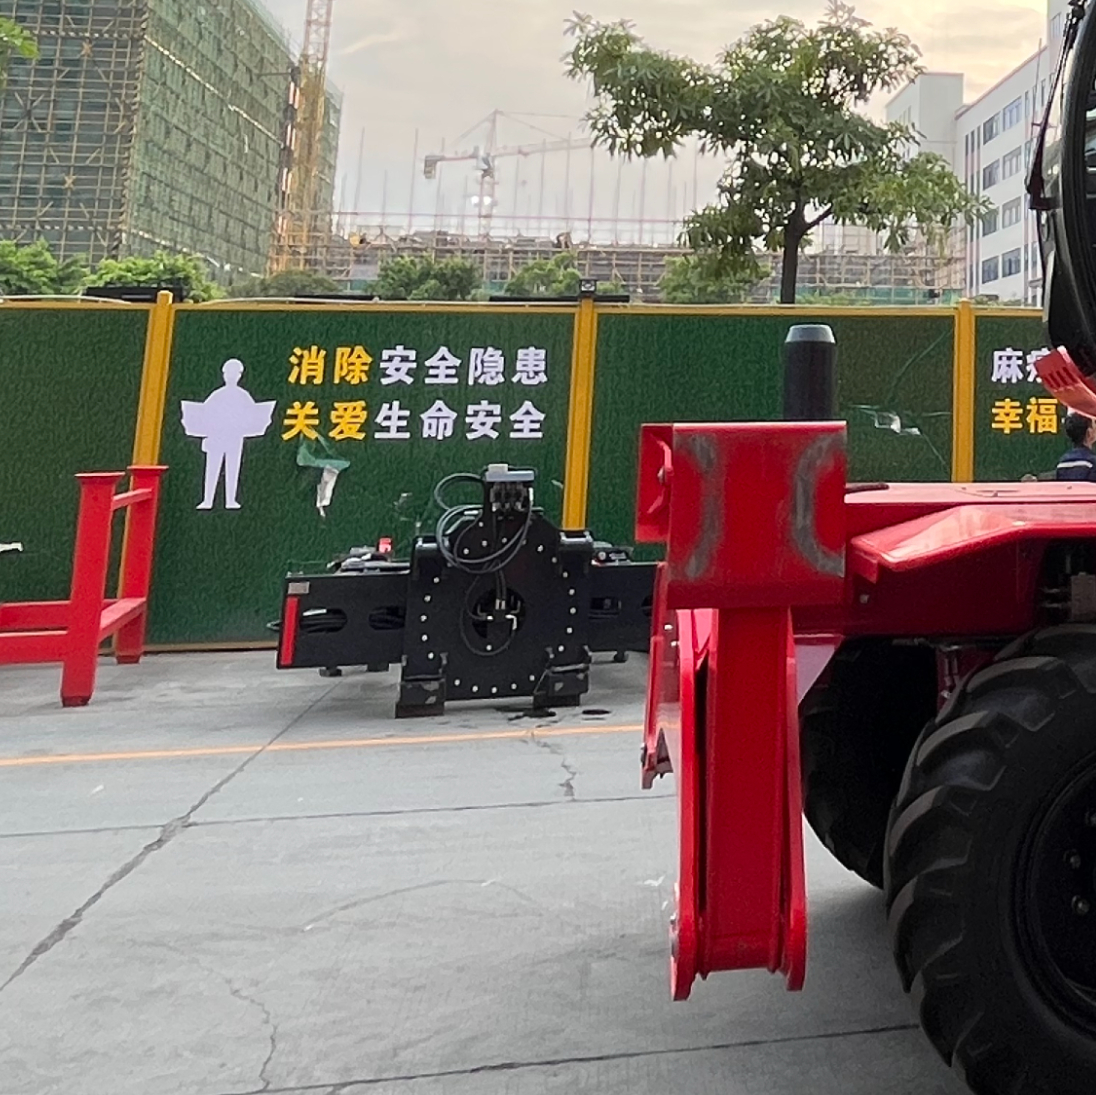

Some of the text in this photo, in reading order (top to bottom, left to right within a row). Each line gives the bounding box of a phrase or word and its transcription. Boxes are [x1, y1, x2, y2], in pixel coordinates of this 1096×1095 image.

[288, 345, 548, 386] 消除安全隐患
[281, 400, 546, 441] 关爱生命安全
